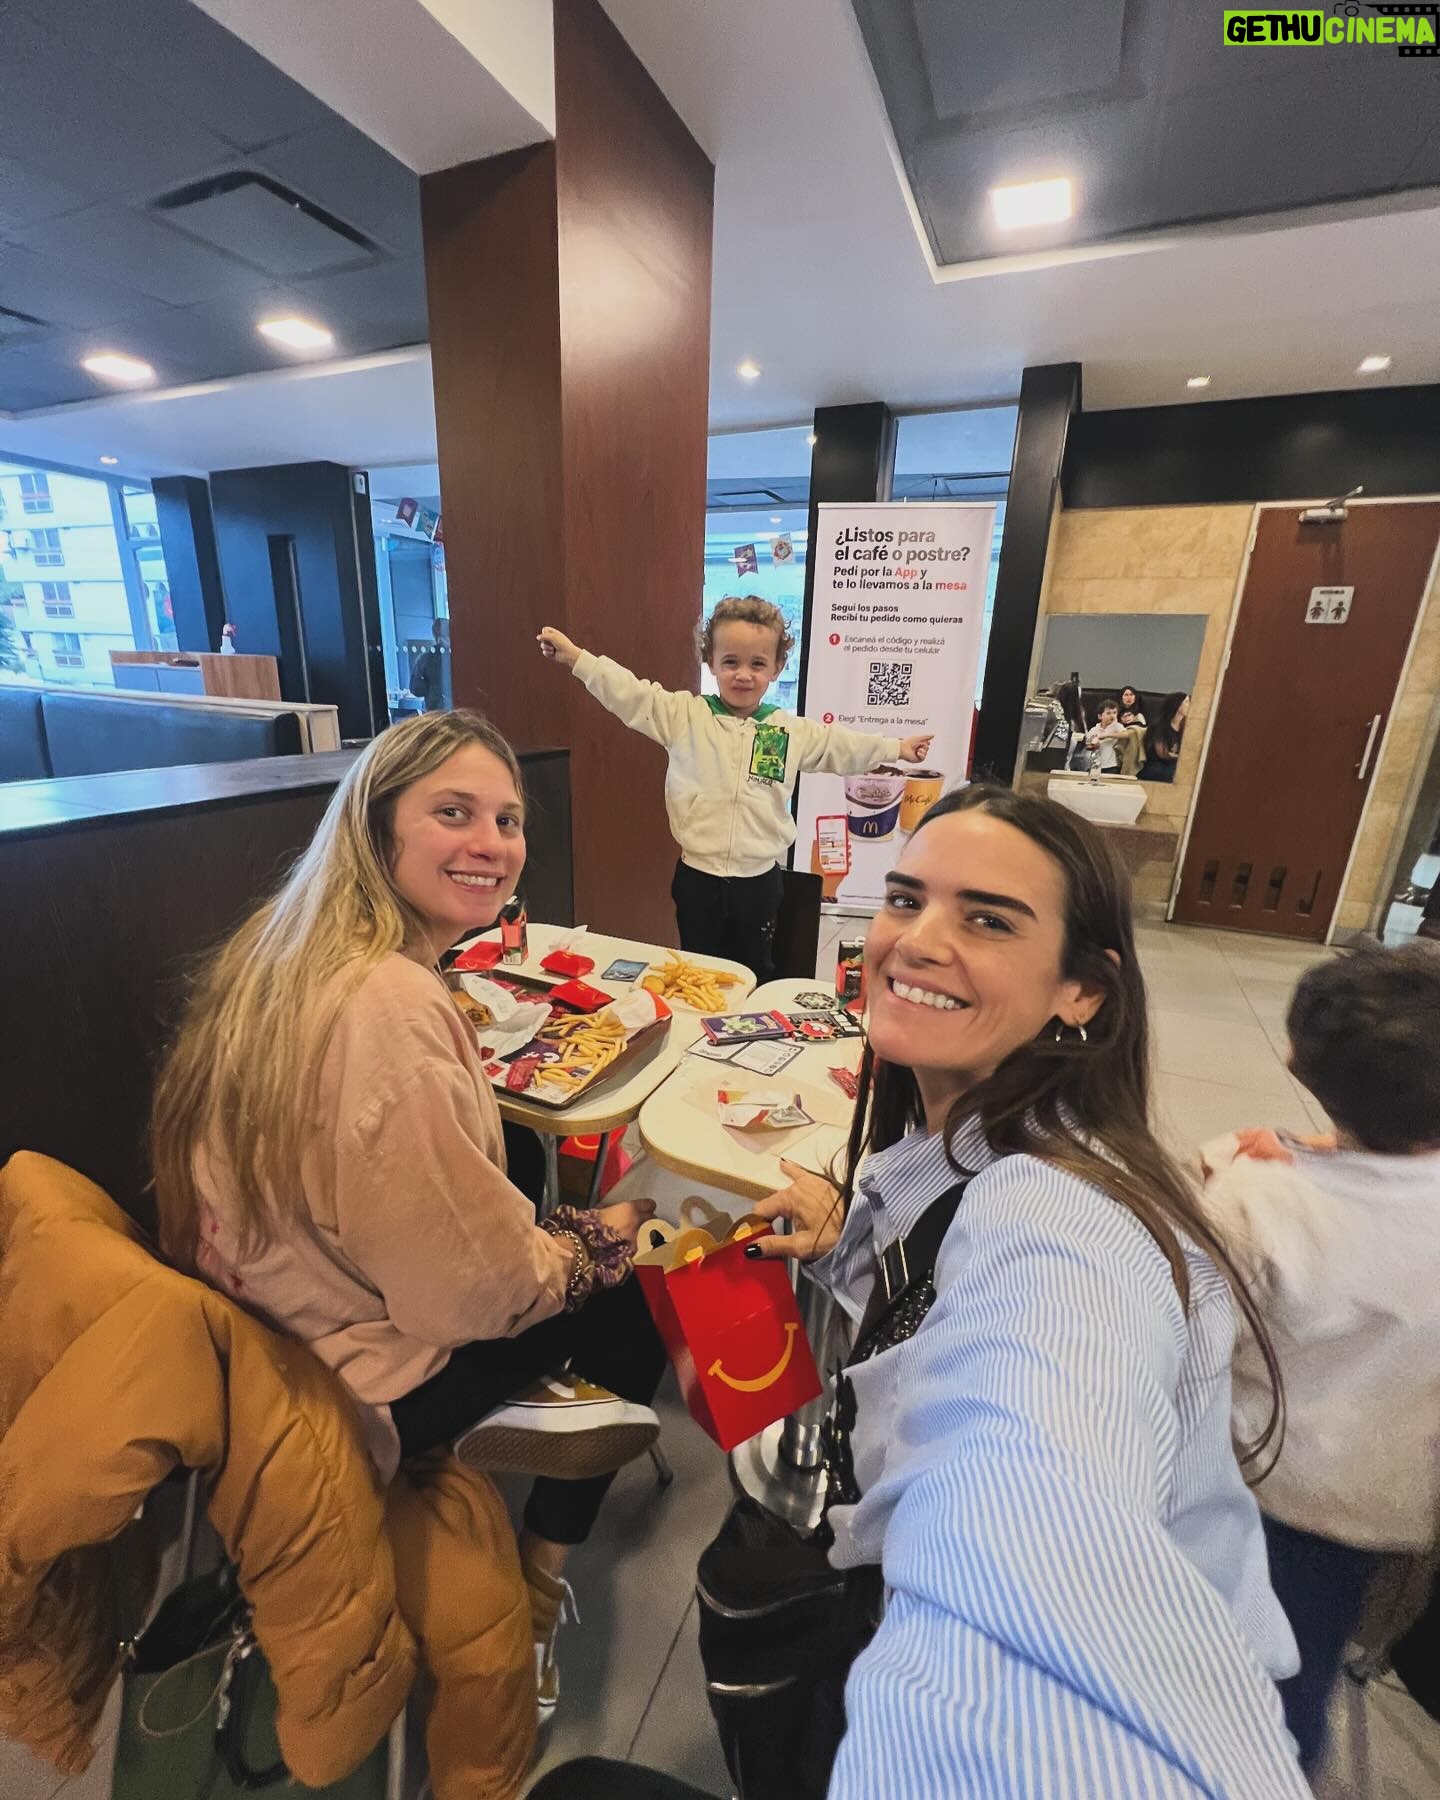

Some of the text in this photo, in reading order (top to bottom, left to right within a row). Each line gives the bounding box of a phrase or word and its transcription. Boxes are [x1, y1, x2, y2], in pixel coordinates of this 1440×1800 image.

[835, 527, 936, 546] ¿Listos para
[834, 545, 971, 565] el café o postre?
[861, 567, 880, 579] por
[882, 566, 892, 577] la
[894, 567, 918, 580] App
[920, 568, 927, 580] y
[833, 579, 967, 590] te lo llevamos a la mesa
[858, 603, 870, 613] los
[872, 605, 899, 614] pasos
[860, 614, 869, 622] tu
[870, 614, 901, 624] pedido
[902, 615, 927, 624] como
[929, 615, 963, 625] quieras
[878, 636, 885, 644] el
[914, 638, 919, 647] y
[852, 645, 878, 654] pedido
[880, 646, 903, 654] desde
[914, 646, 941, 655] celular
